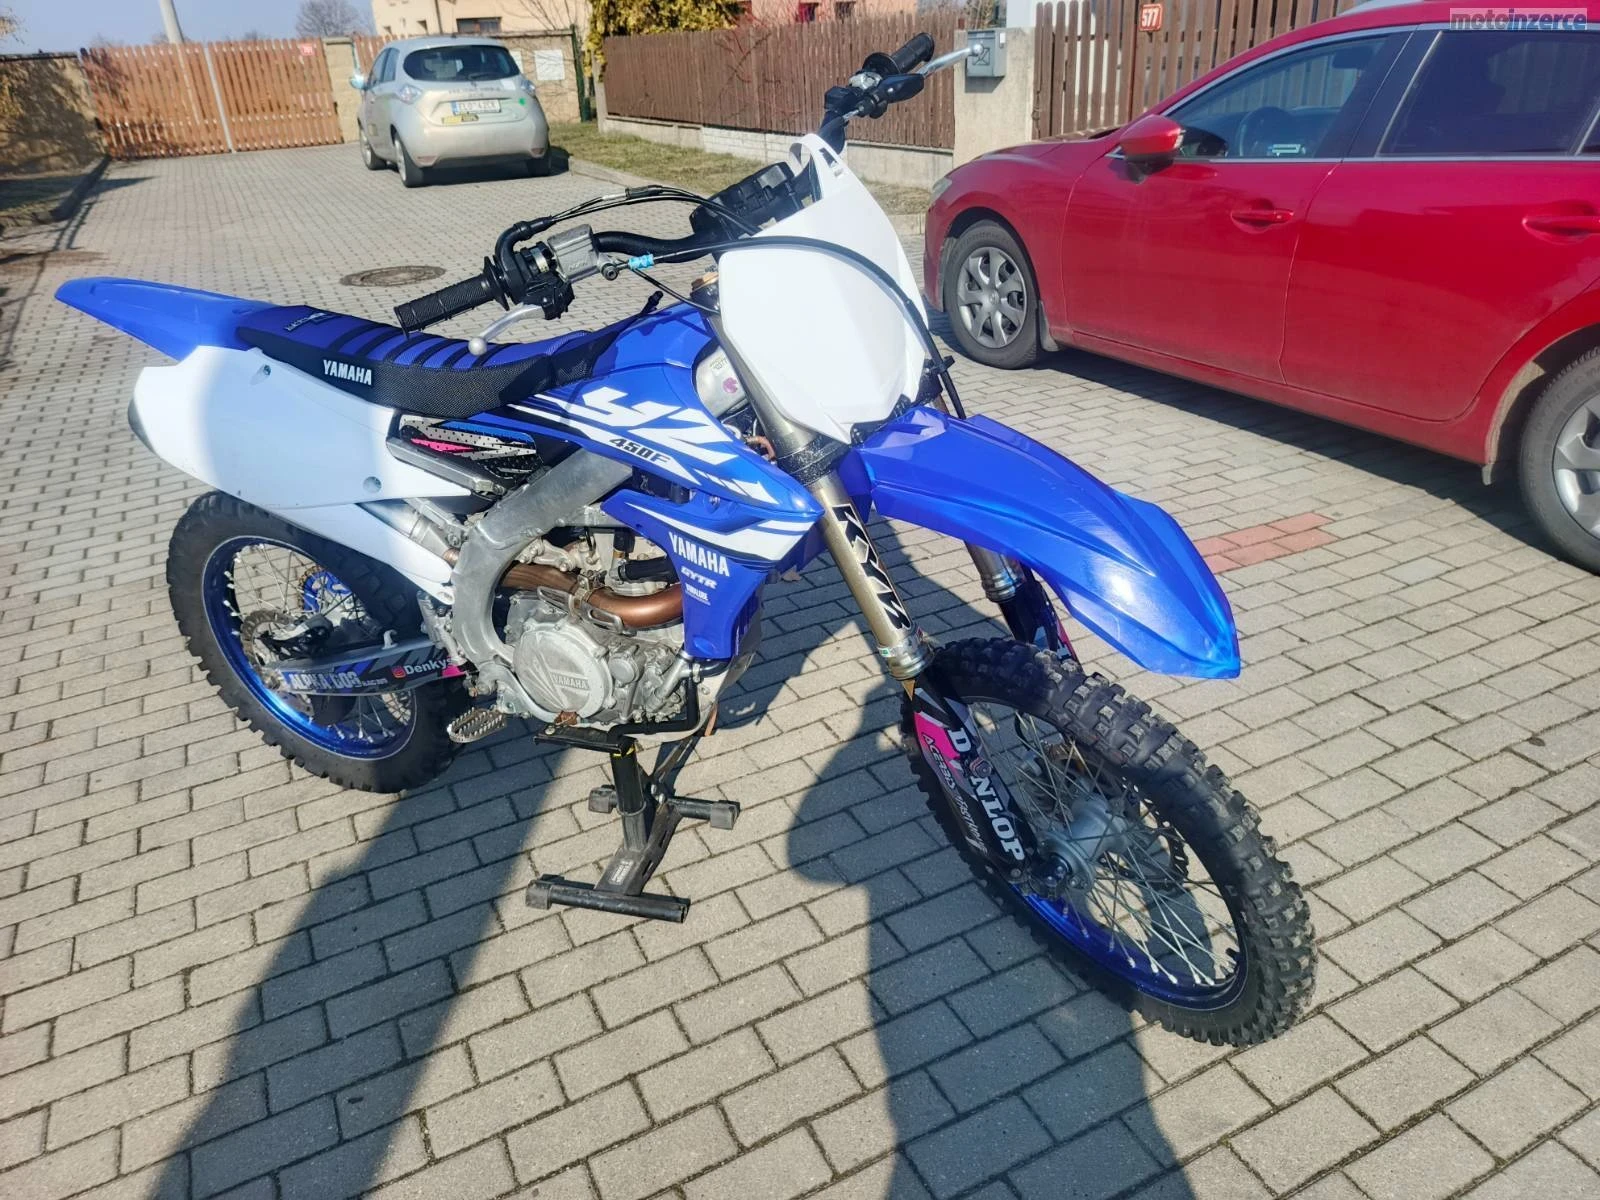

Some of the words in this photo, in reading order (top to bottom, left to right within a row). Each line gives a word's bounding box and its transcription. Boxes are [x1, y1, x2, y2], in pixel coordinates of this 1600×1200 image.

[1142, 8, 1159, 26] 577
[322, 359, 372, 386] YAMAHA
[609, 437, 670, 463] 450F
[668, 531, 730, 577] YAMAHA
[551, 671, 590, 690] YAMAHA
[947, 727, 1026, 861] DNLOP
